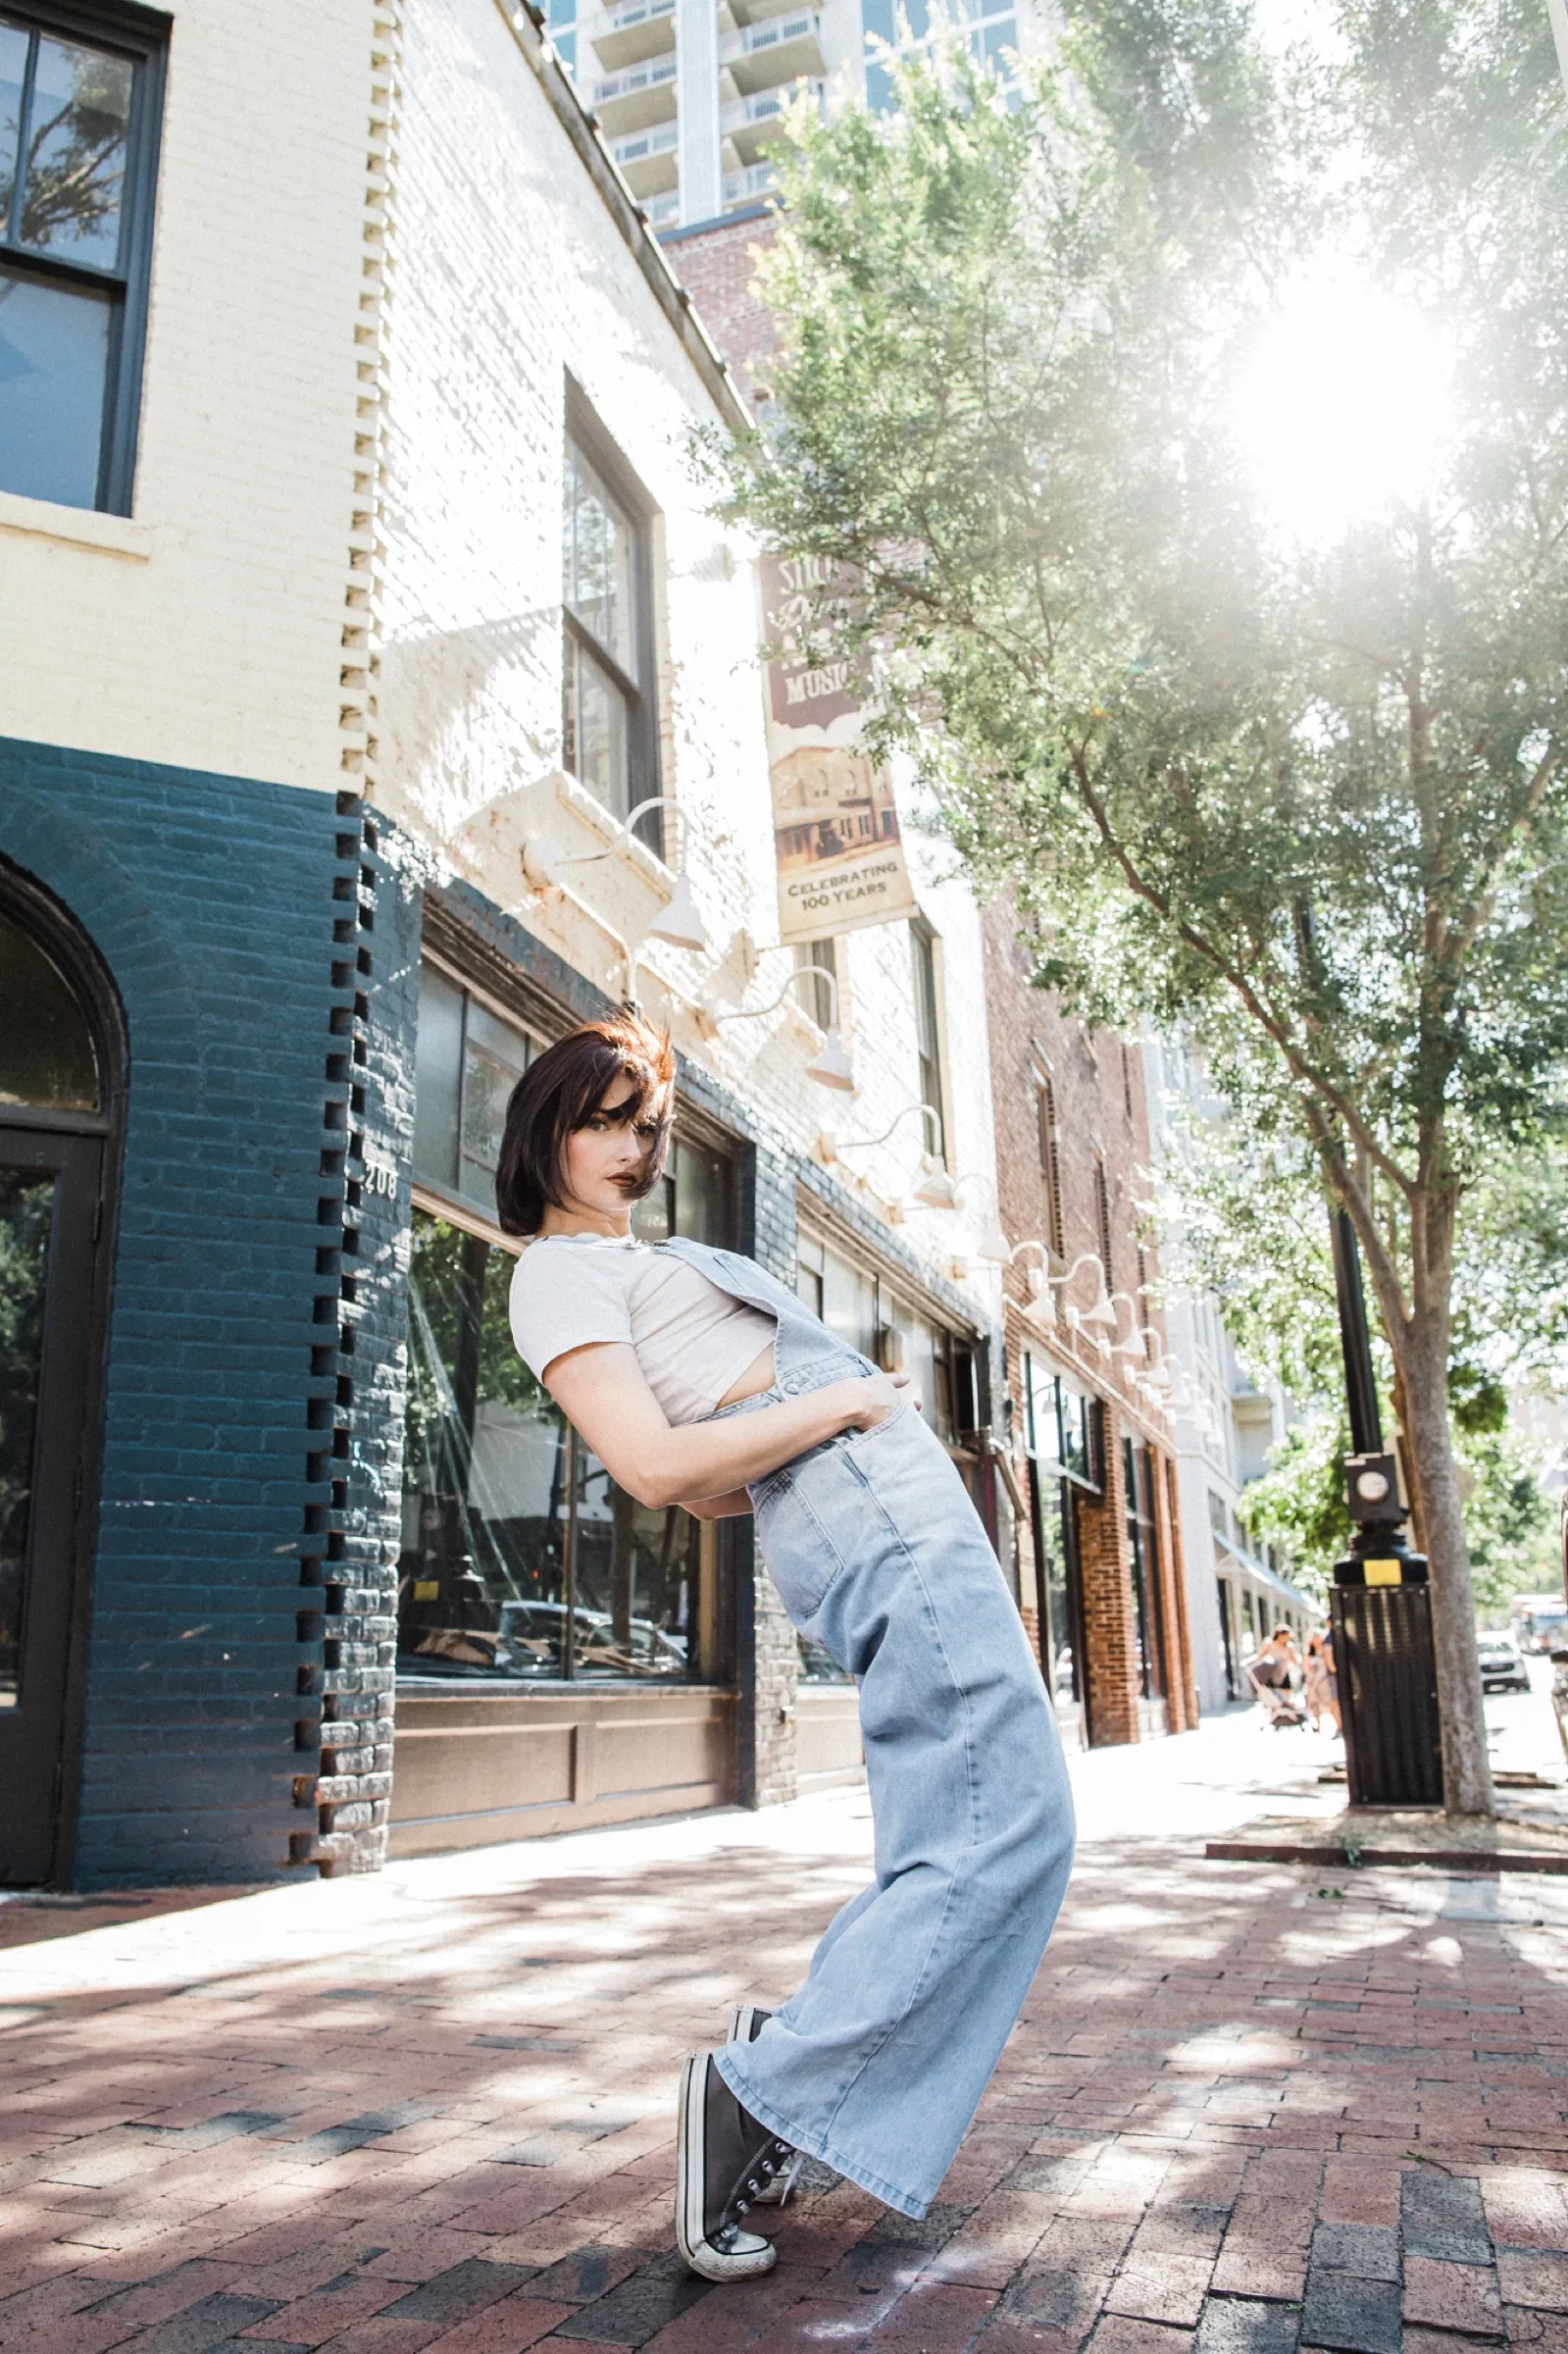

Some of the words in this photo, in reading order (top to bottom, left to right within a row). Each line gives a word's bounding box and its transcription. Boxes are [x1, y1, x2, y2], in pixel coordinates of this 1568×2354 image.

[787, 861, 899, 896] CELEBRATING
[801, 894, 830, 911] 100
[833, 881, 887, 903] YEARS
[365, 1164, 397, 1201] 208
